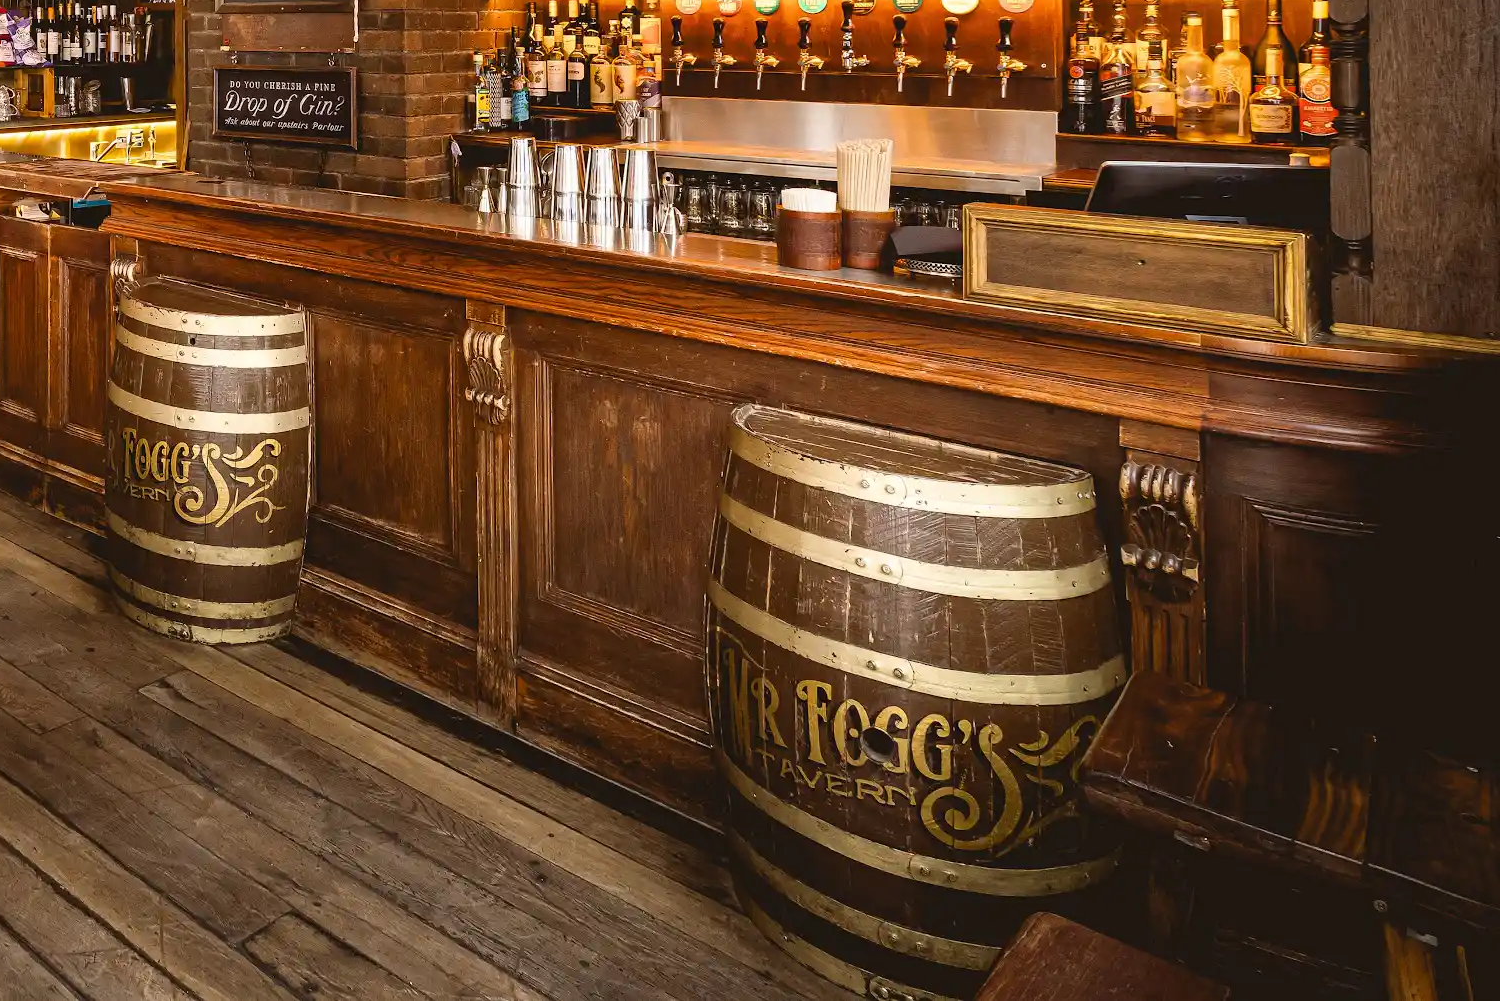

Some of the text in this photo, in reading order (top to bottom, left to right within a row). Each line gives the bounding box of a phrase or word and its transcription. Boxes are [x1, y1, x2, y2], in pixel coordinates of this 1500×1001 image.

[224, 90, 345, 119] Drop of Gin?
[230, 80, 336, 92] DO YOU CHERISH A FINE
[224, 117, 344, 132] Ask about our upstairs Parlour
[122, 427, 230, 526] FOGG'S
[723, 647, 1023, 852] MR FOGG'S
[754, 747, 919, 808] TAVERN
